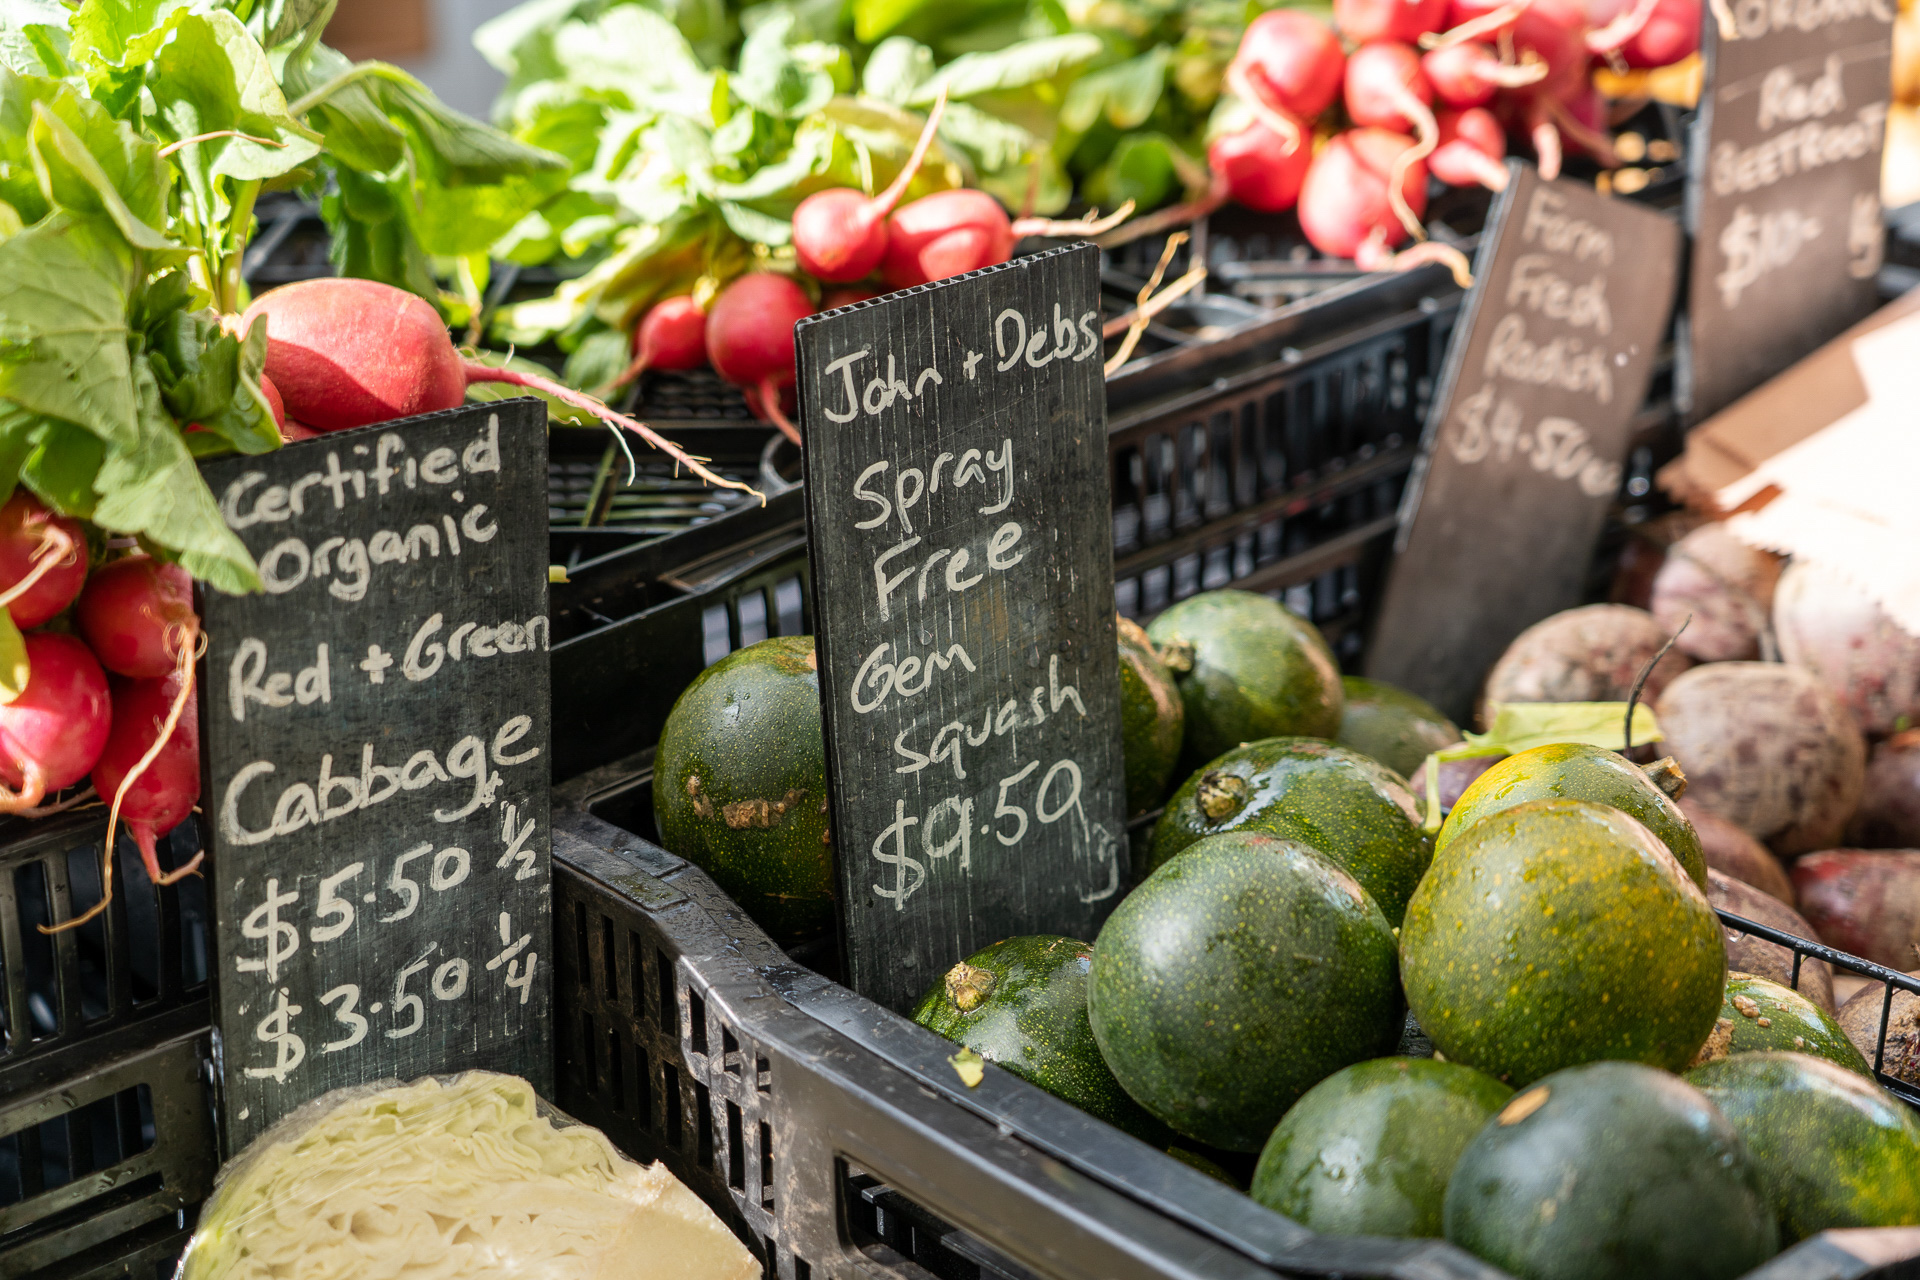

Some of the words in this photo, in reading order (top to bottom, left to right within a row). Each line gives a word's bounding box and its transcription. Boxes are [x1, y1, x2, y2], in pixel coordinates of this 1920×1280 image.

[1758, 54, 1845, 131] Red
[1522, 186, 1614, 267] Farm
[1506, 253, 1611, 335] Fresh
[824, 343, 942, 423] John
[996, 303, 1098, 372] Debs
[221, 413, 500, 529] Certified
[853, 438, 1014, 533] Spray
[260, 490, 498, 601] Organic
[873, 521, 1023, 622] Free
[228, 638, 331, 722] Red
[360, 644, 393, 684] +
[402, 612, 550, 682] Green
[851, 642, 976, 713] Gem
[220, 714, 540, 845] Cabbage
[872, 759, 1082, 911] $9.50
[236, 841, 471, 983] $5.50
[244, 941, 469, 1083] $3.50
